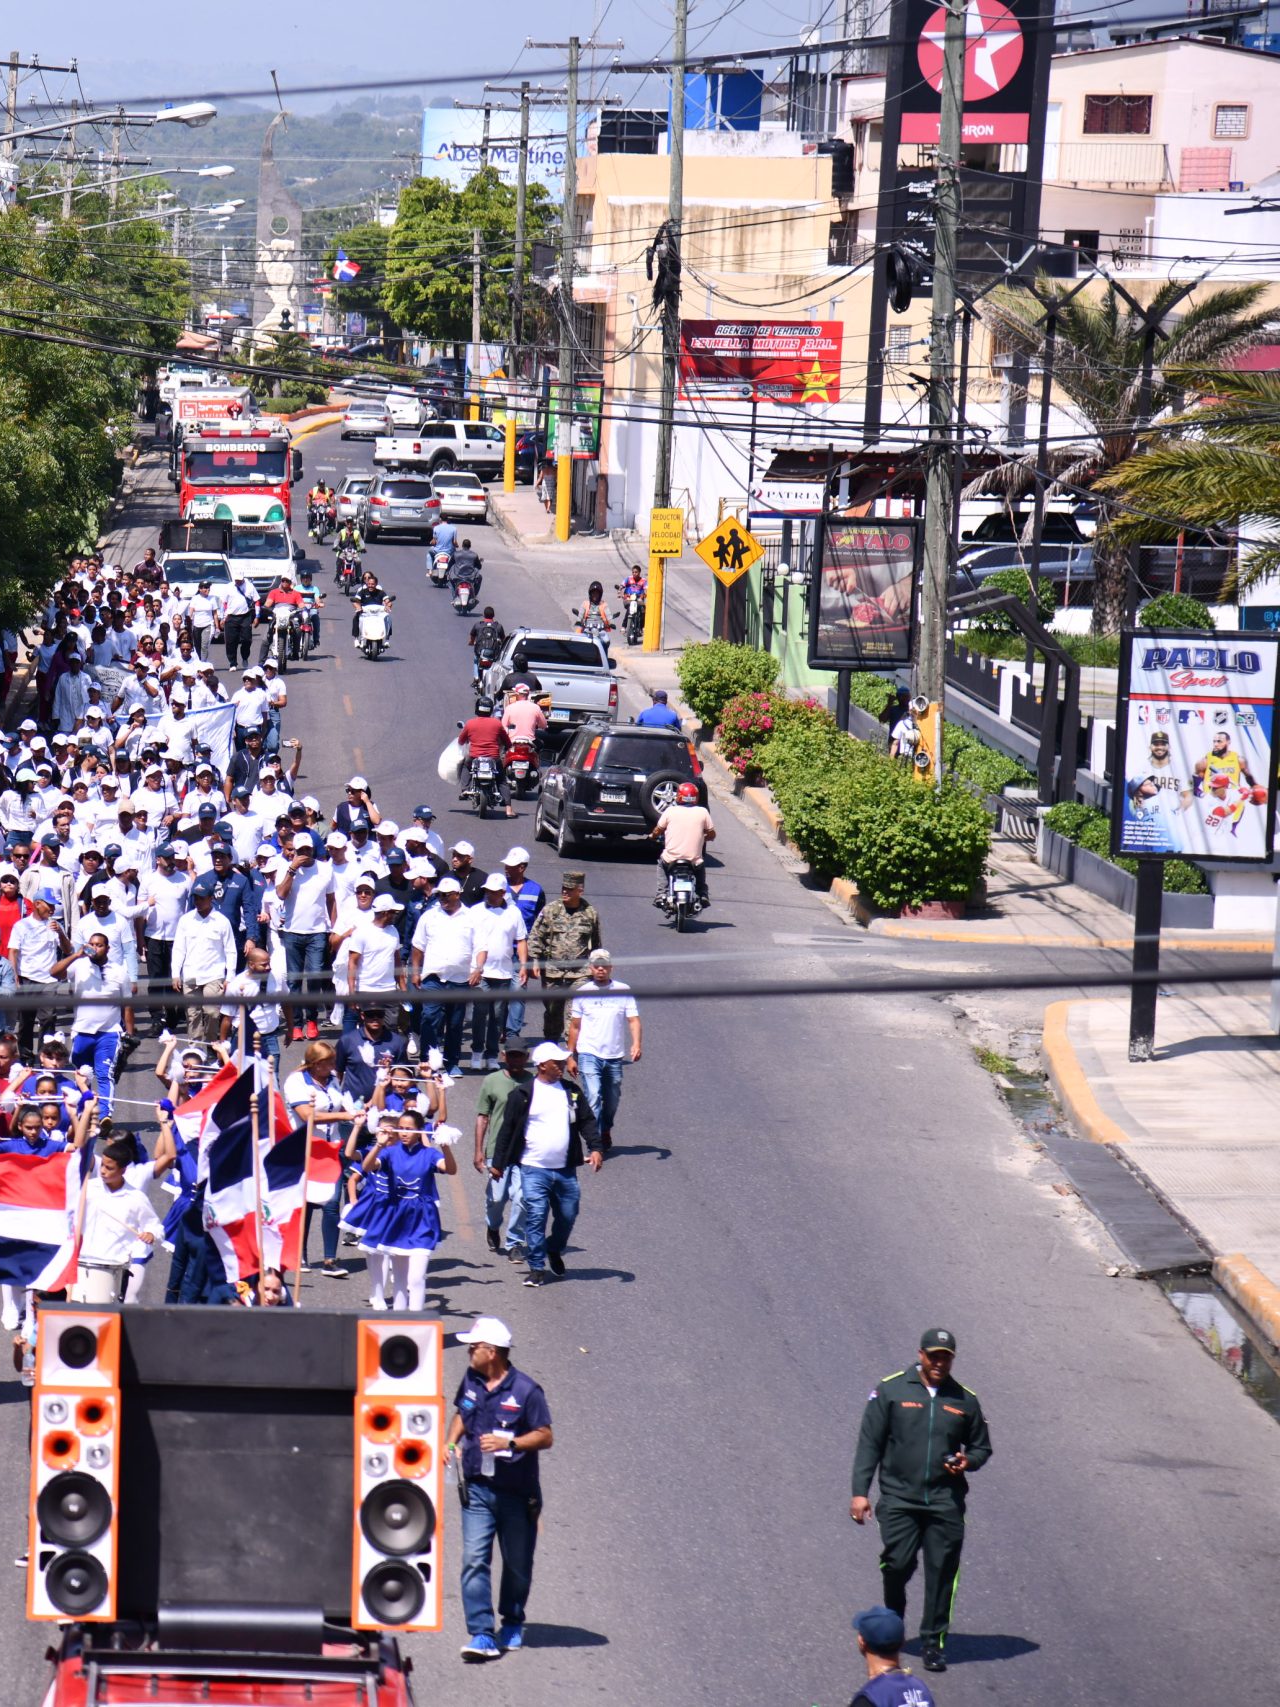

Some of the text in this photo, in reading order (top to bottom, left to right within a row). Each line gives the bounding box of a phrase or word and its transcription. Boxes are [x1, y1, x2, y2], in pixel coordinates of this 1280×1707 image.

[757, 326, 770, 336] DE
[691, 338, 749, 349] ESTRELLA
[752, 338, 800, 349] MOTORS
[198, 402, 228, 411] brav
[205, 443, 266, 452] BOMBEROS
[767, 490, 820, 500] PATRIA
[1141, 647, 1261, 675] PABLO
[1169, 670, 1229, 690] Sport
